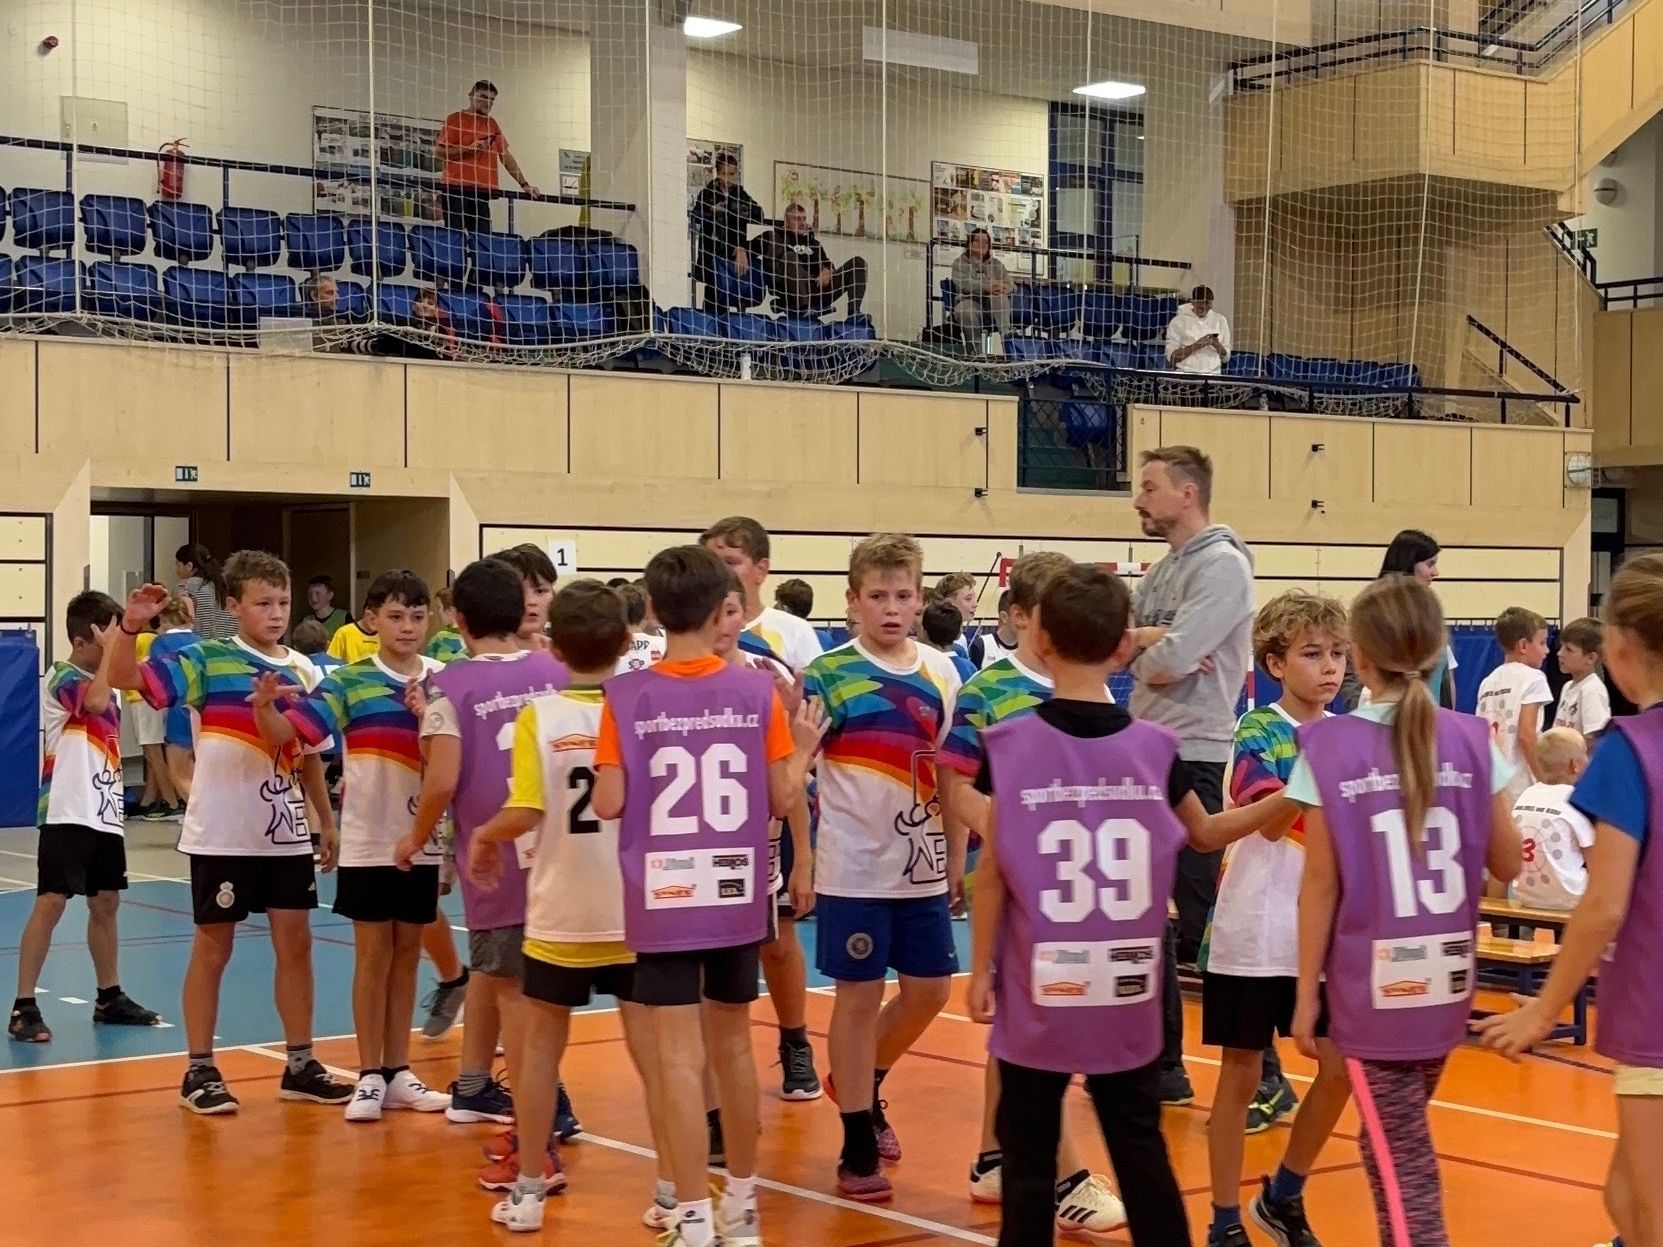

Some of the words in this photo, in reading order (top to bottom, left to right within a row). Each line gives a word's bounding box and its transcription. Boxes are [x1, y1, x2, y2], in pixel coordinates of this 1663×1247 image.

[556, 548, 569, 566] 1
[568, 766, 601, 834] 2
[649, 743, 748, 836] 26
[1037, 818, 1152, 922] 39
[1370, 806, 1467, 917] 13
